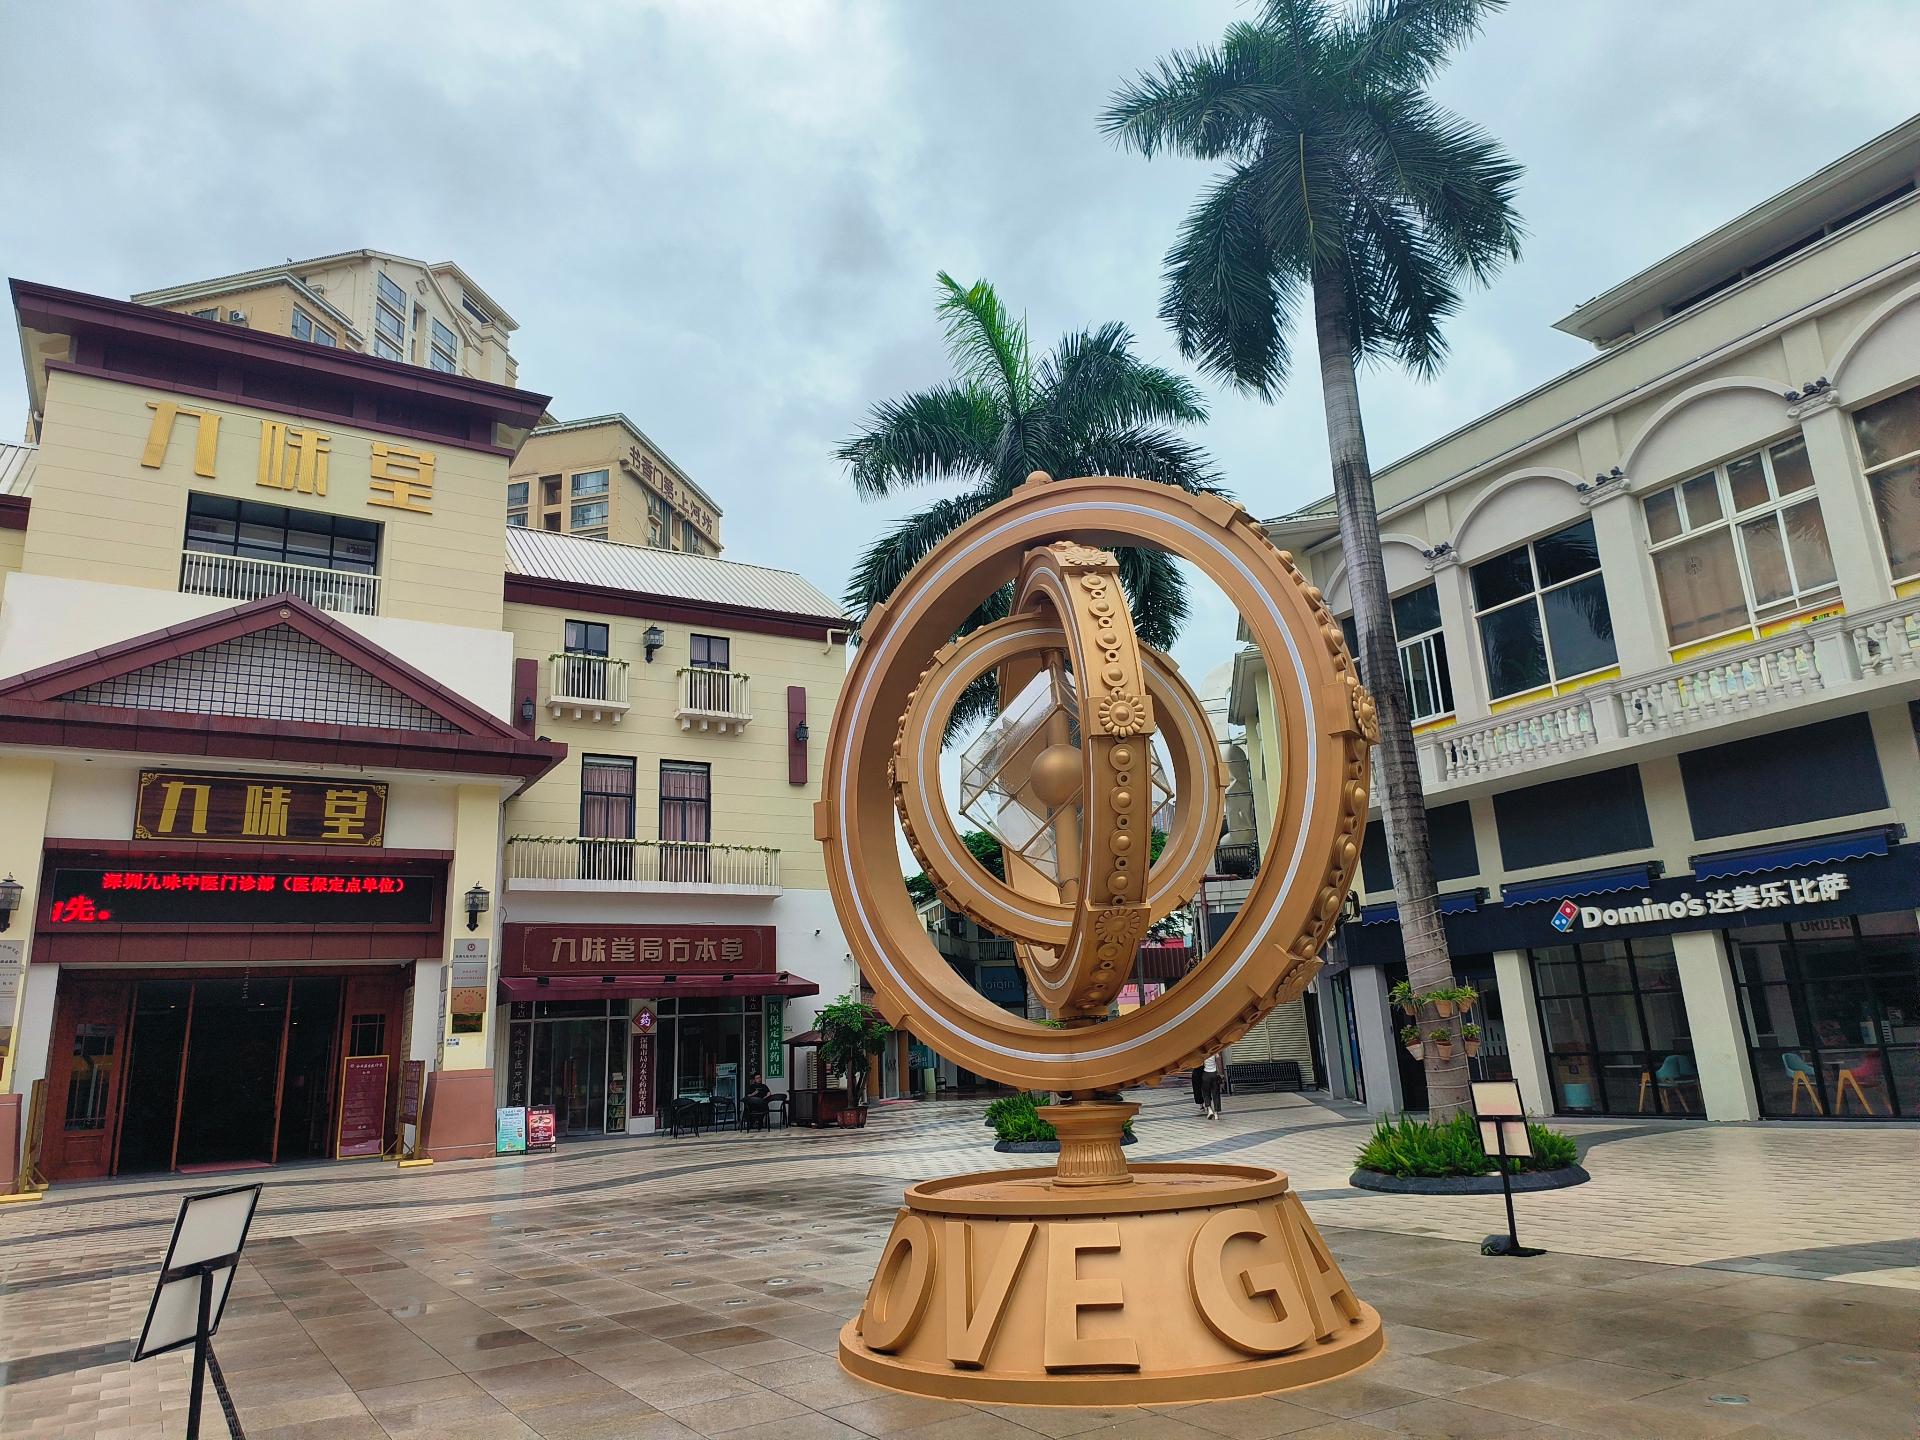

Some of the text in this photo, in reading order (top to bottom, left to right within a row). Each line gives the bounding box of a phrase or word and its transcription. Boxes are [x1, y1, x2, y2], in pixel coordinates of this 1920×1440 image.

[141, 401, 437, 514] 九味堂
[157, 781, 369, 839] 九味堂
[1580, 873, 1850, 928] Domino's 达美乐比萨
[552, 937, 744, 962] 九味堂局方本草
[640, 1012, 651, 1026] 药
[769, 1003, 780, 1075] 医保定点药店
[855, 1206, 1140, 1374] OVE
